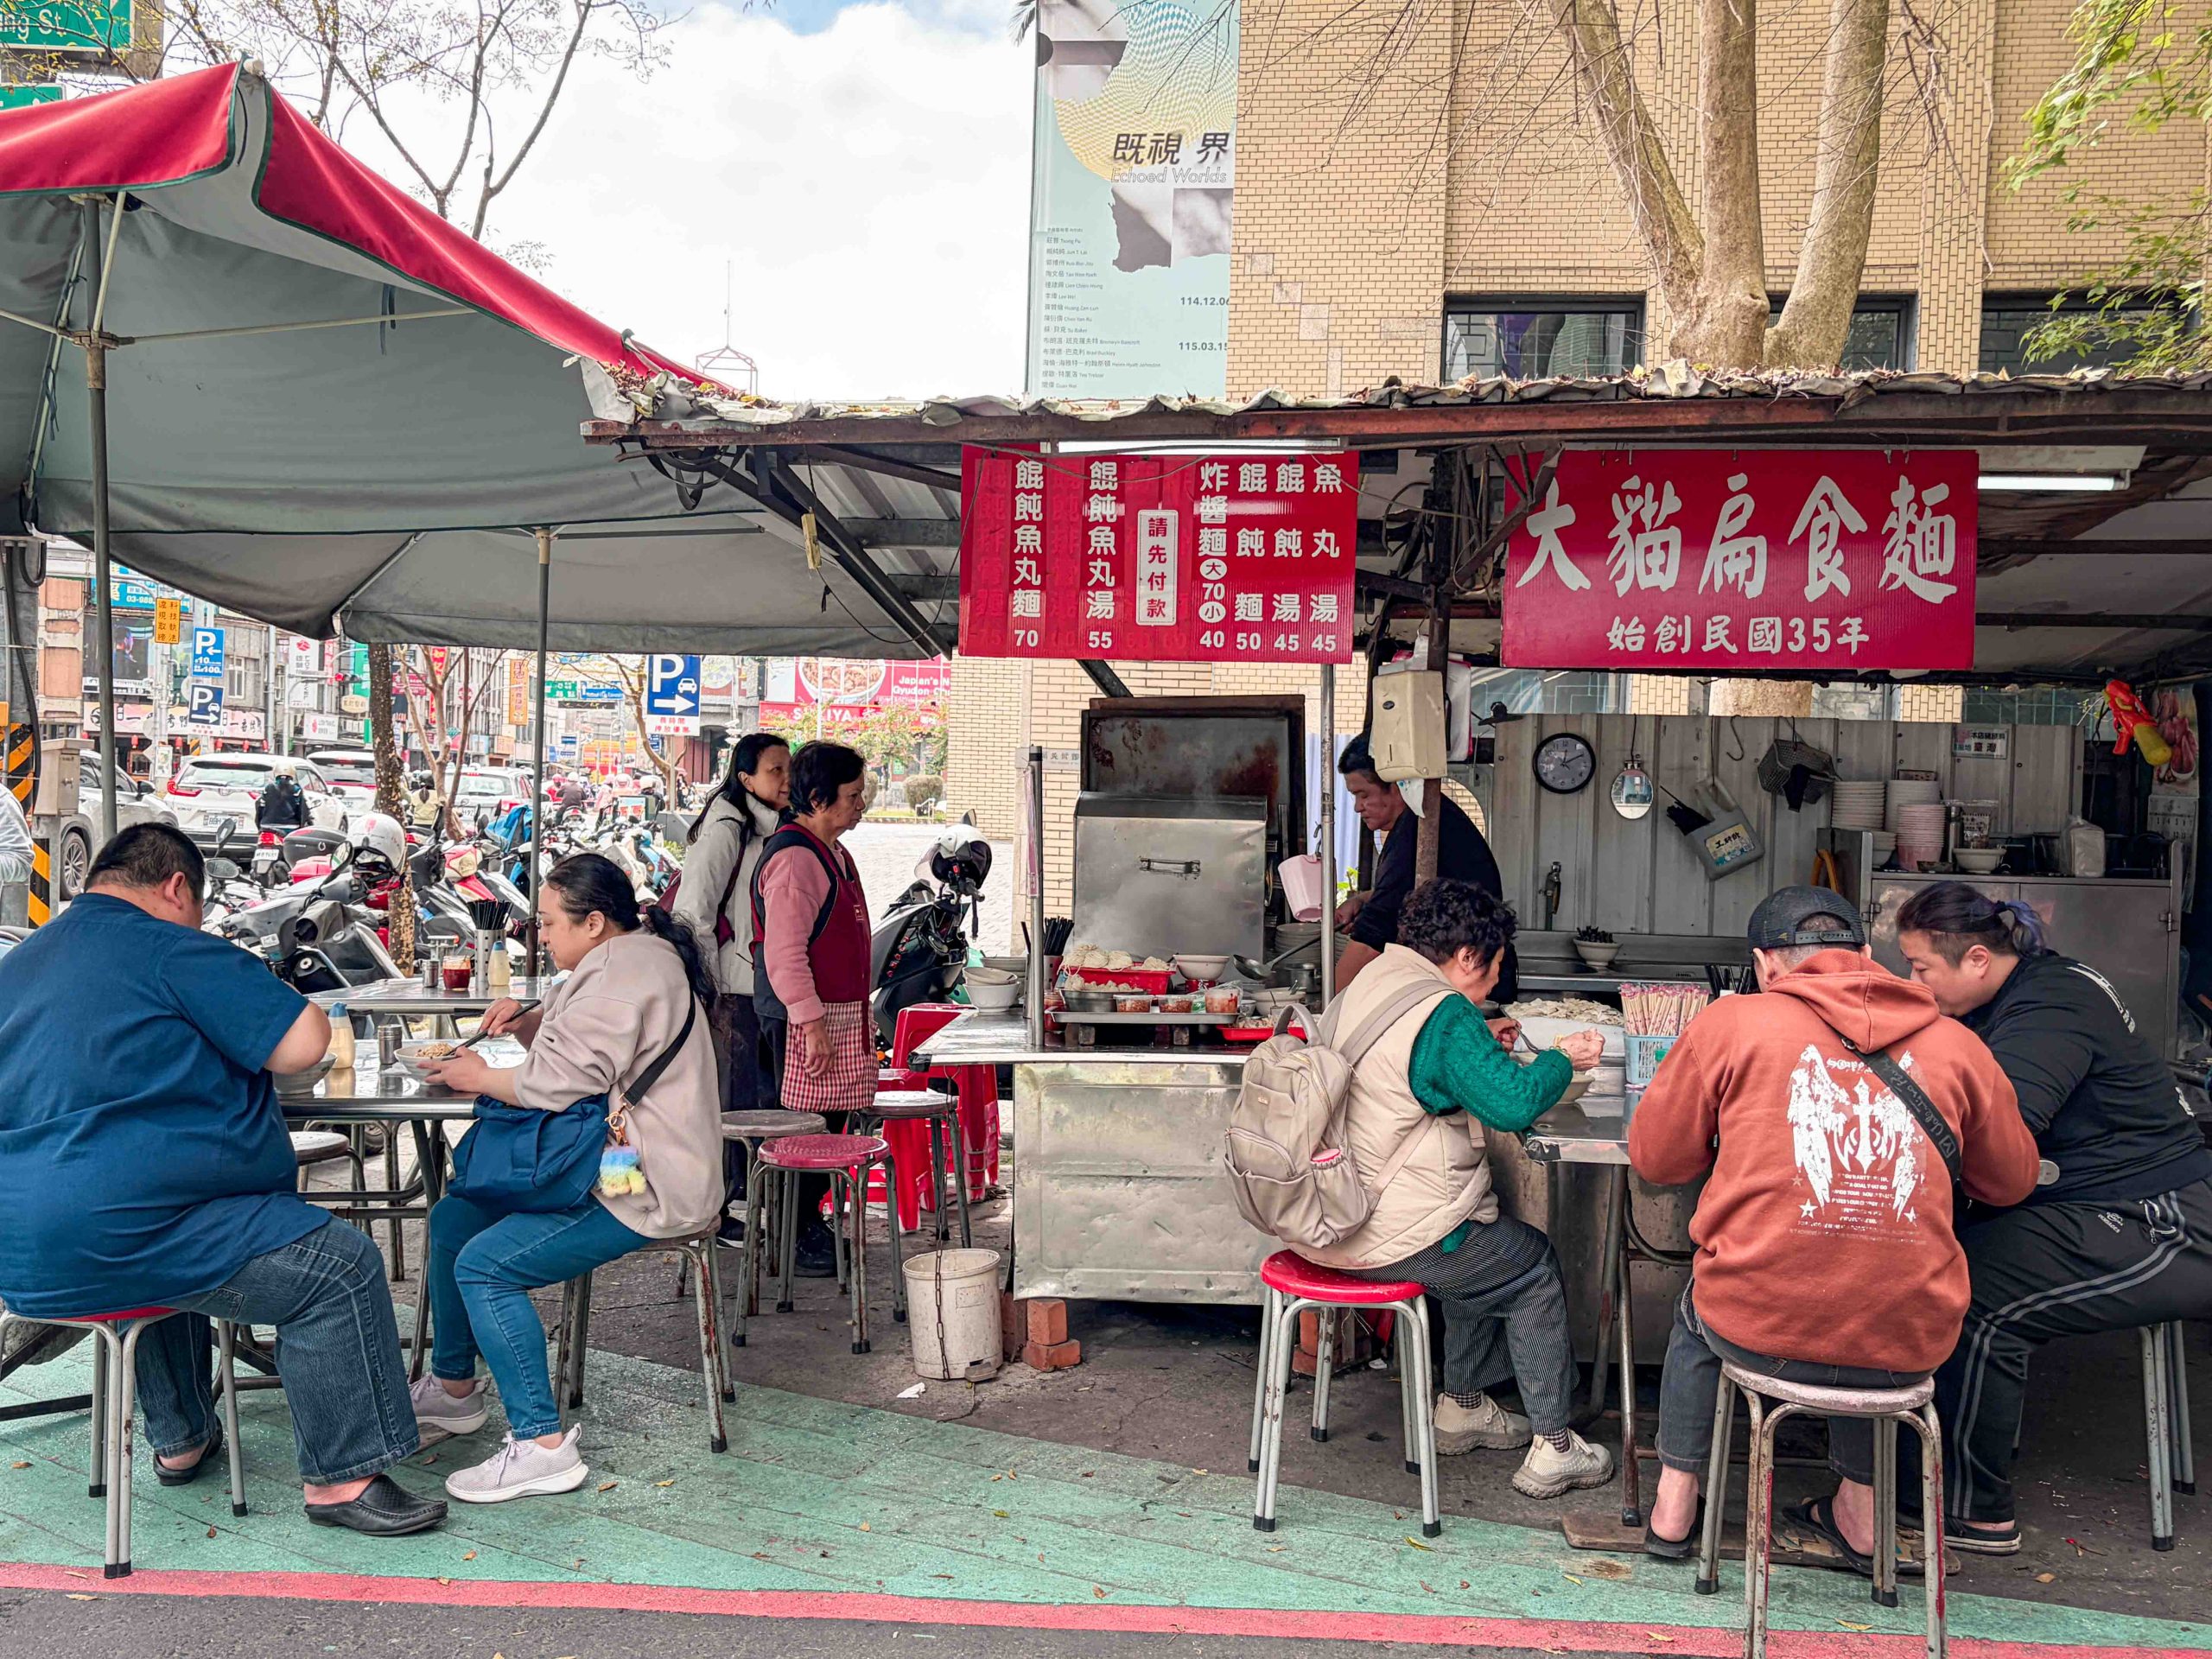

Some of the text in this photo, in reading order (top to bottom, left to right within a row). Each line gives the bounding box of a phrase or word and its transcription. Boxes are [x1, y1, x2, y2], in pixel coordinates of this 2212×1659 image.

[1197, 132, 1230, 163] 界
[1111, 167, 1227, 183] Echoed Worlds
[1198, 462, 1230, 556] 炸醬麵
[1013, 460, 1044, 618] 餛飩魚丸麵
[1086, 461, 1118, 620] 餛飩魚丸湯
[1235, 462, 1268, 622] 餛飩麵
[1272, 463, 1305, 622] 餛飩湯
[1309, 464, 1343, 623] 魚丸湯
[1516, 473, 1957, 604] 大貓扁食麵
[1147, 518, 1167, 618] 請先付款
[1202, 582, 1225, 601] 70
[195, 631, 217, 655] P
[1014, 629, 1039, 647] 70
[1088, 631, 1113, 649] 55
[1199, 630, 1225, 648] 40
[1236, 632, 1262, 650] 50
[1274, 633, 1300, 652] 45
[1311, 634, 1337, 652] 45
[1606, 614, 1870, 655] 始創民國35年
[652, 653, 684, 693] P
[192, 687, 213, 711] P
